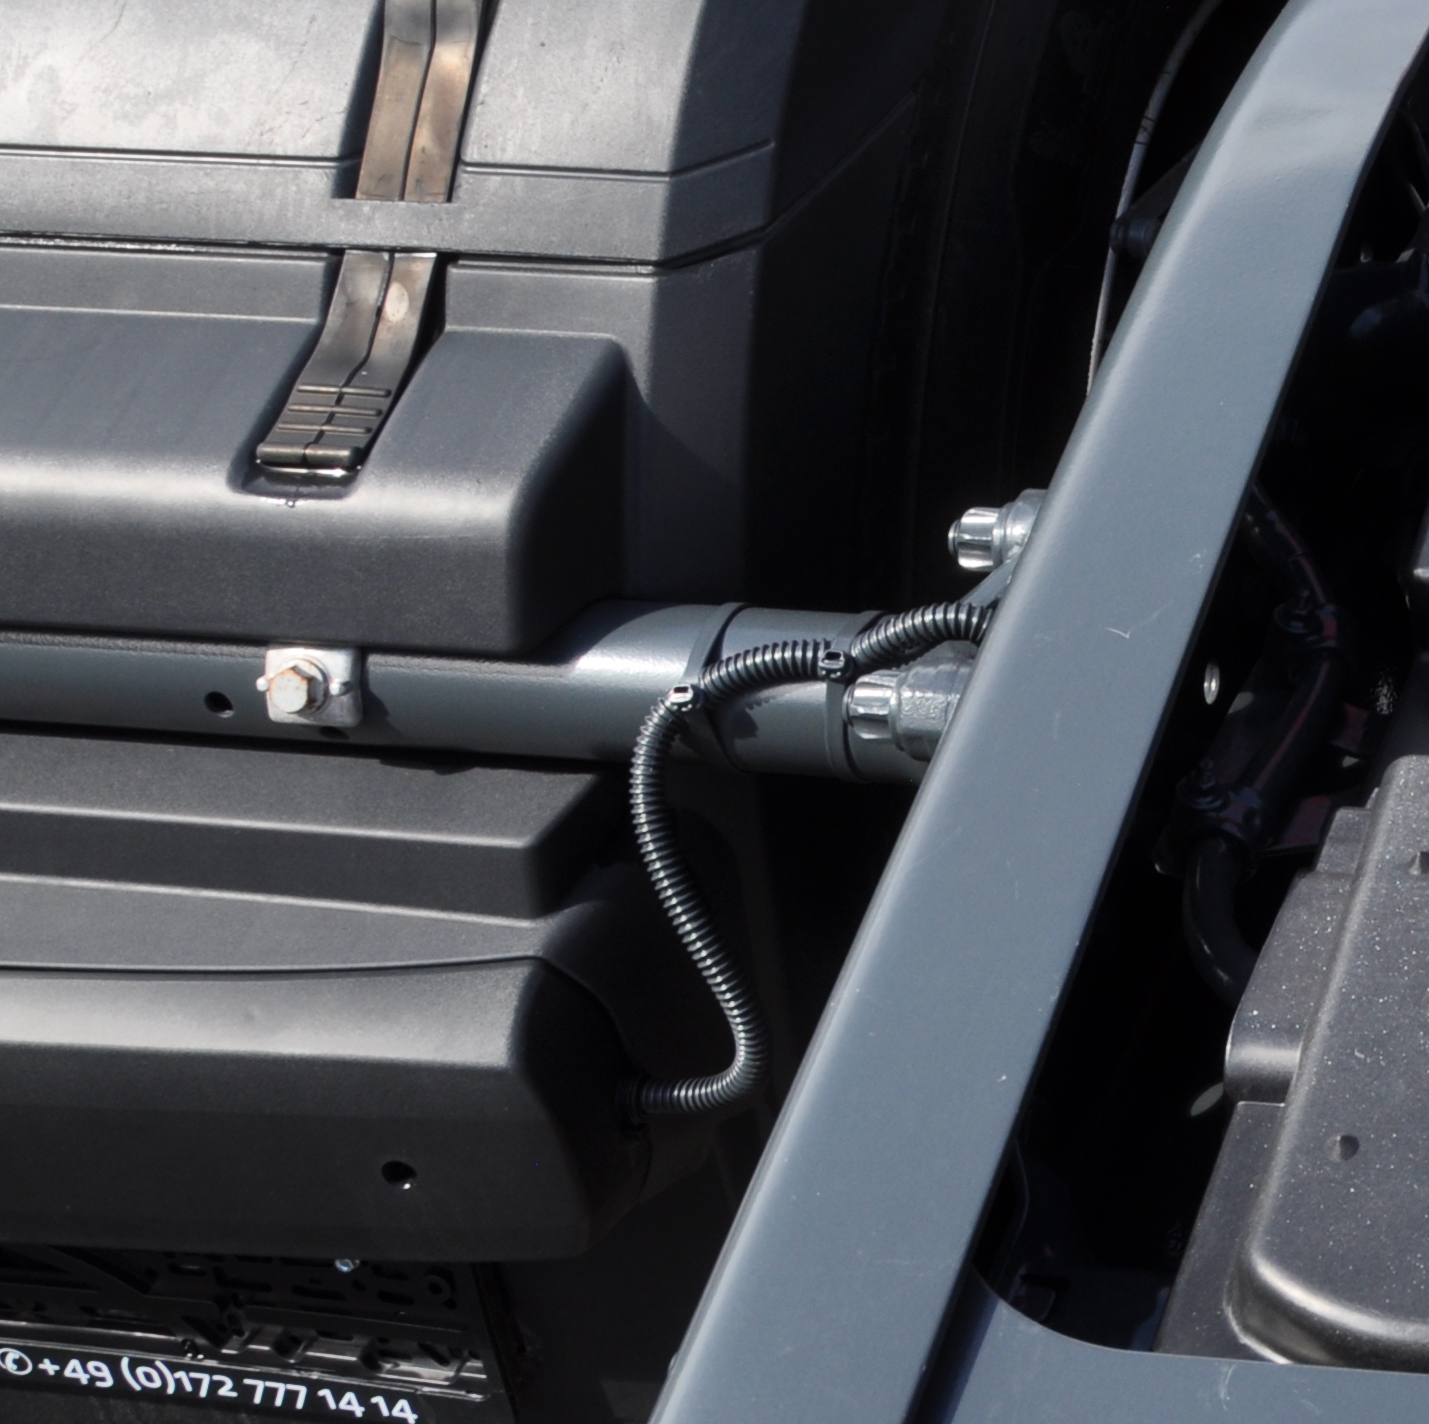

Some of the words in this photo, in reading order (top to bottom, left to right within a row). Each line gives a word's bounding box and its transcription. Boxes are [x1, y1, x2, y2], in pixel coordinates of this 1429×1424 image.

[38, 1358, 114, 1388] +49
[243, 1378, 307, 1409] 777
[317, 1388, 366, 1418] 14
[370, 1395, 418, 1424] 14
